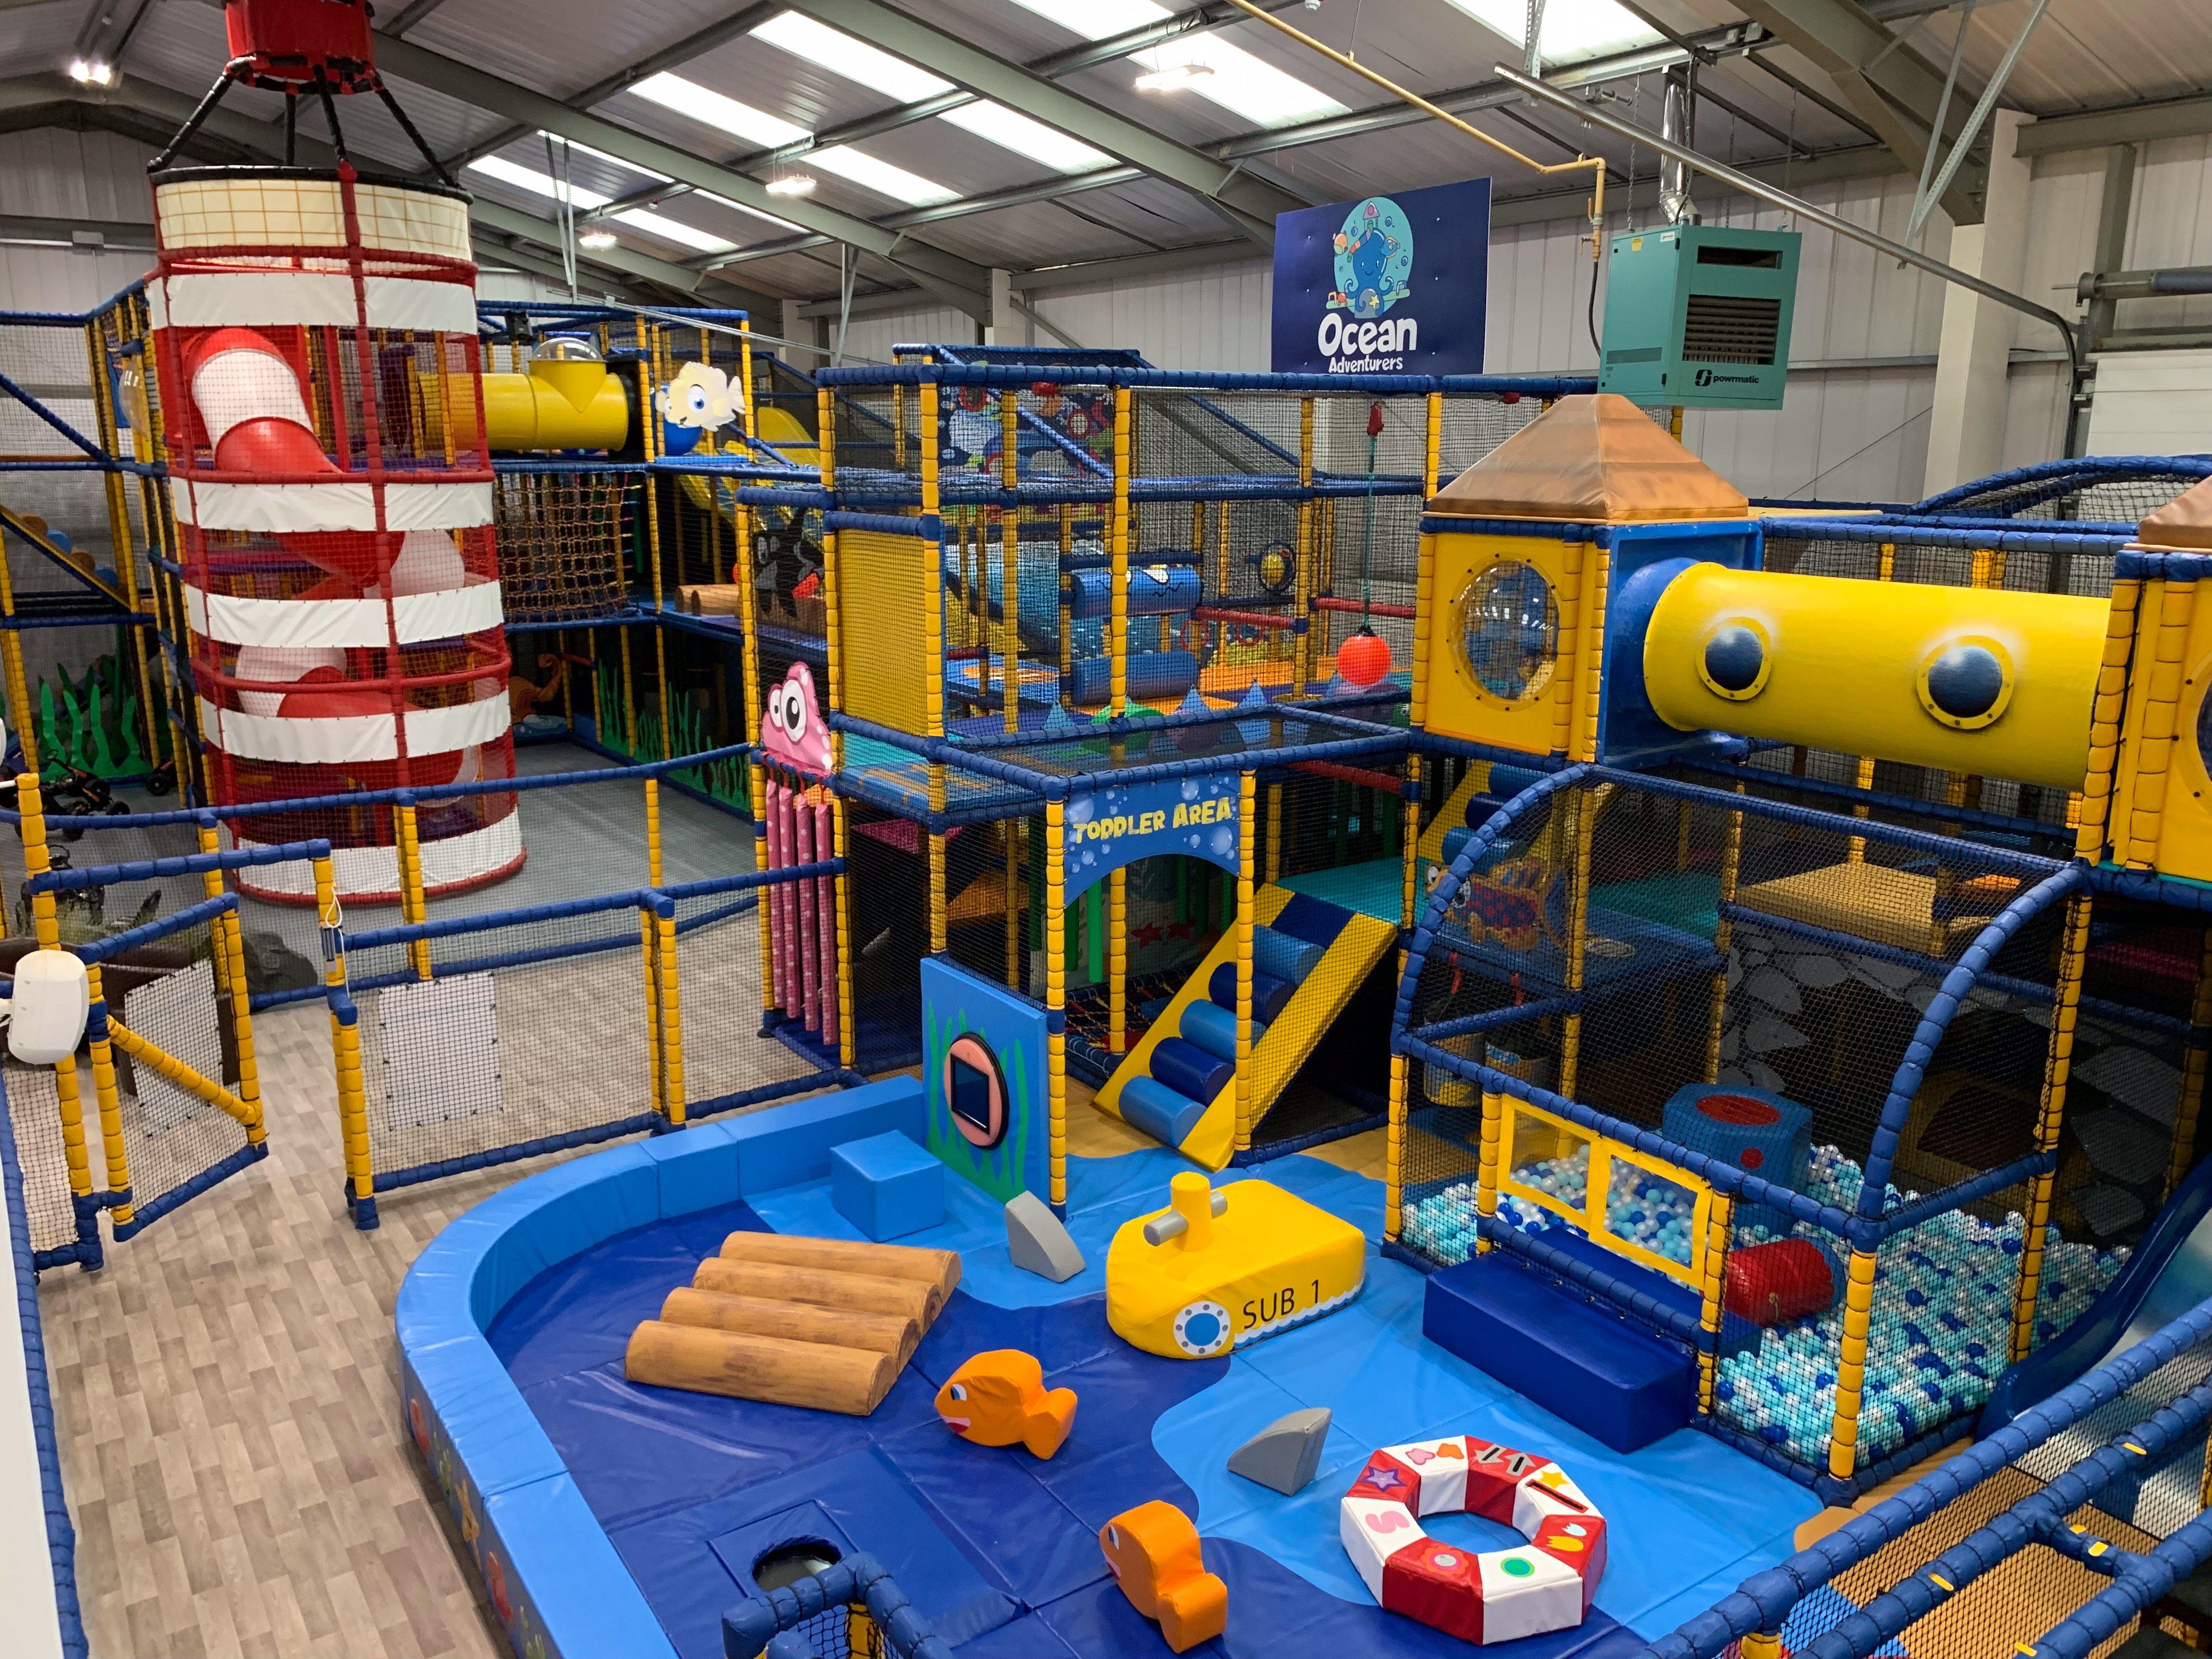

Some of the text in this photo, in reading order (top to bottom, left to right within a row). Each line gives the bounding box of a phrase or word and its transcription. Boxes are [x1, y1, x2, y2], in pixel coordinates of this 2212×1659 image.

[1318, 312, 1418, 357] Ocean
[1328, 354, 1403, 373] Adventurers
[1073, 797, 1232, 844] TODDLER AREA
[1243, 1279, 1319, 1329] SUB 1
